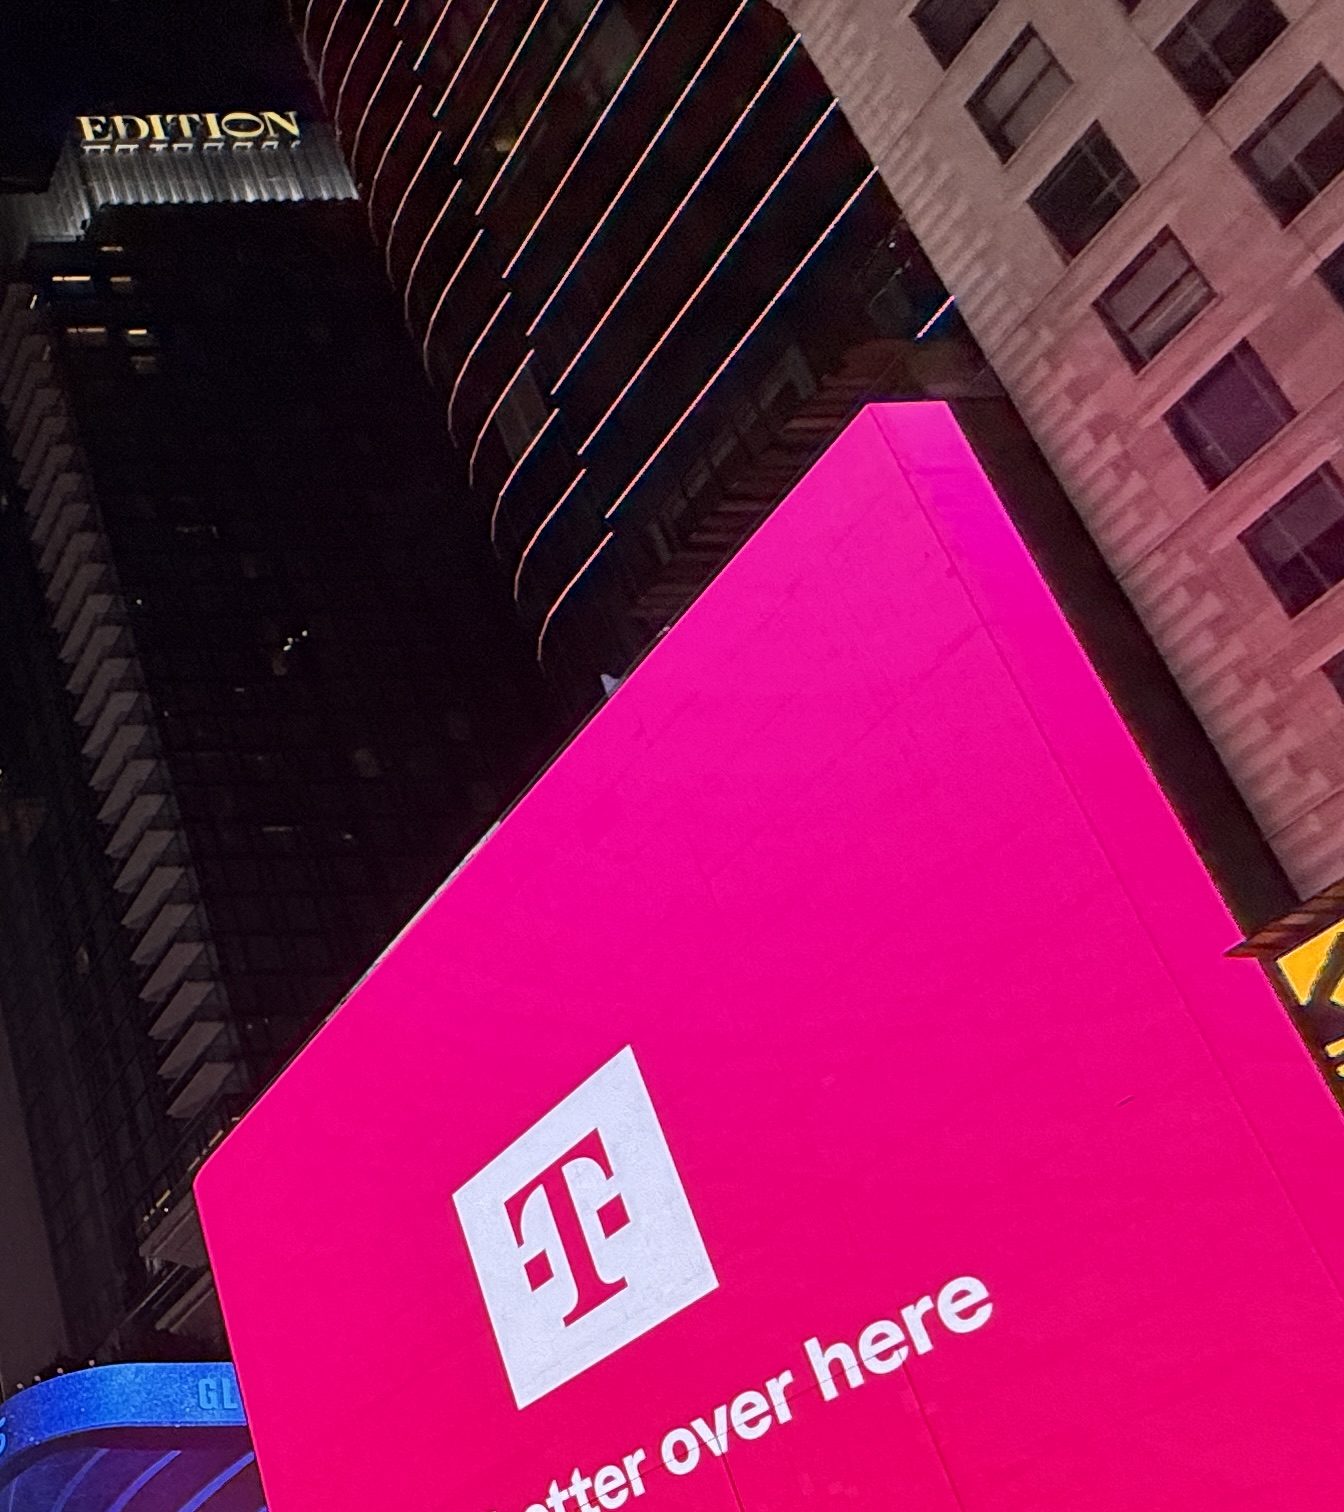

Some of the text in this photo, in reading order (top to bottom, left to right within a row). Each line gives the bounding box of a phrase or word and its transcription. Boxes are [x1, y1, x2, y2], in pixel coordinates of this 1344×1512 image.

[77, 110, 300, 144] EDITION
[503, 1128, 631, 1328] T
[661, 1369, 795, 1476] over
[804, 1275, 994, 1402] here
